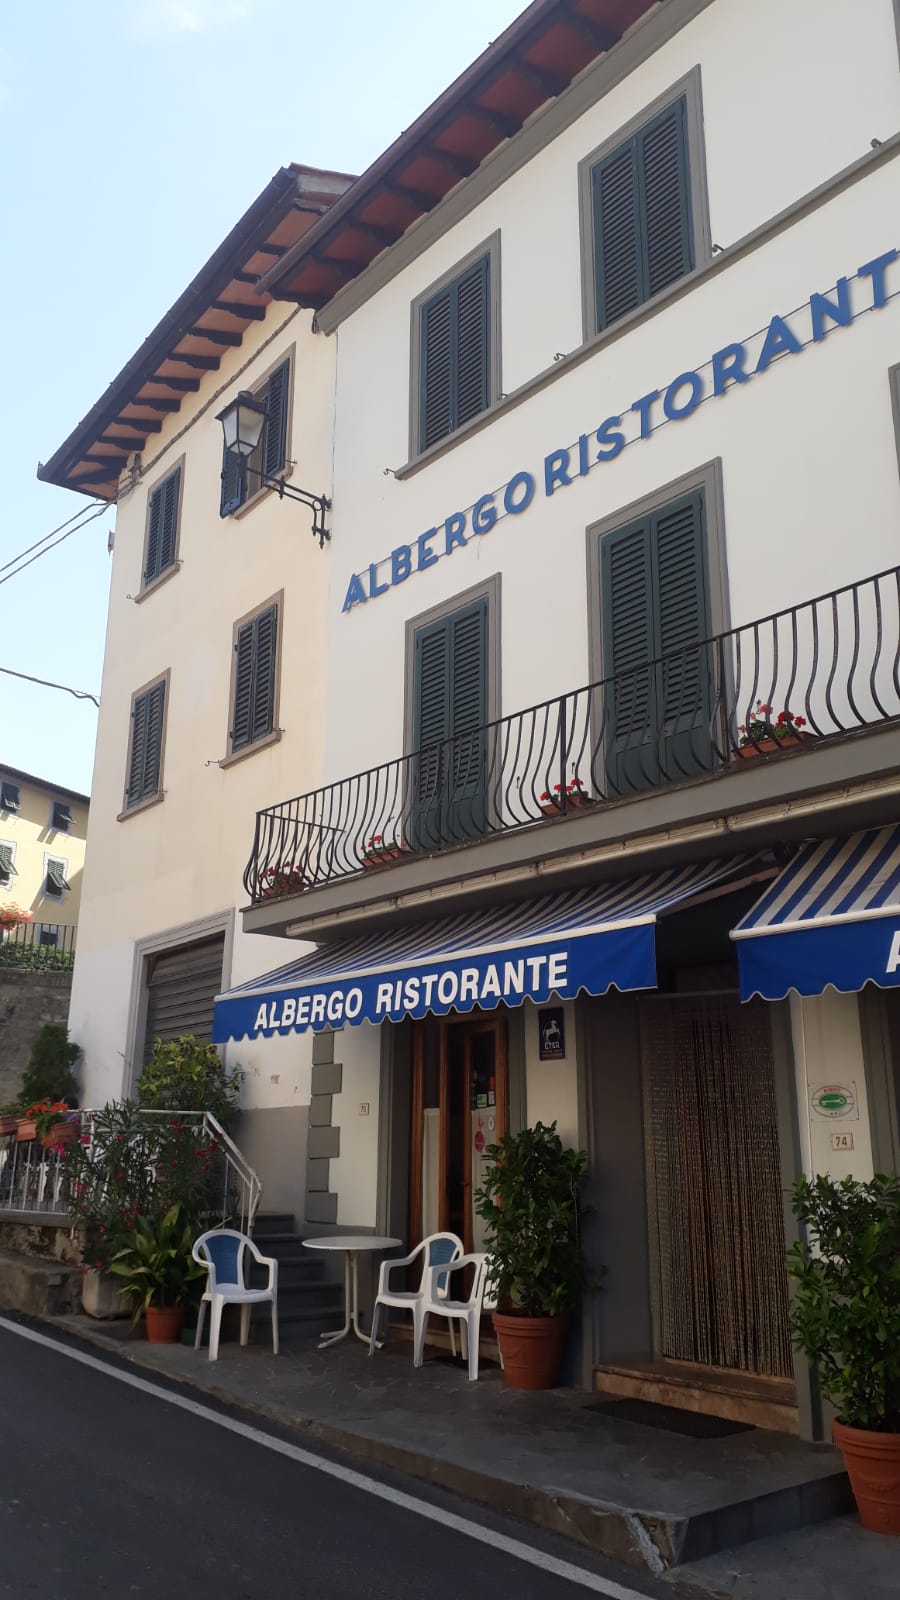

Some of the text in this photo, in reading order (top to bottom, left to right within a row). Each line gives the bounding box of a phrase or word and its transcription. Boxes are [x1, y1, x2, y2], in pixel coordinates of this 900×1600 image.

[341, 248, 898, 613] ALBERGO RISTORANT
[253, 951, 569, 1031] ALBERGO RISTORANTE
[835, 1136, 848, 1147] 74
